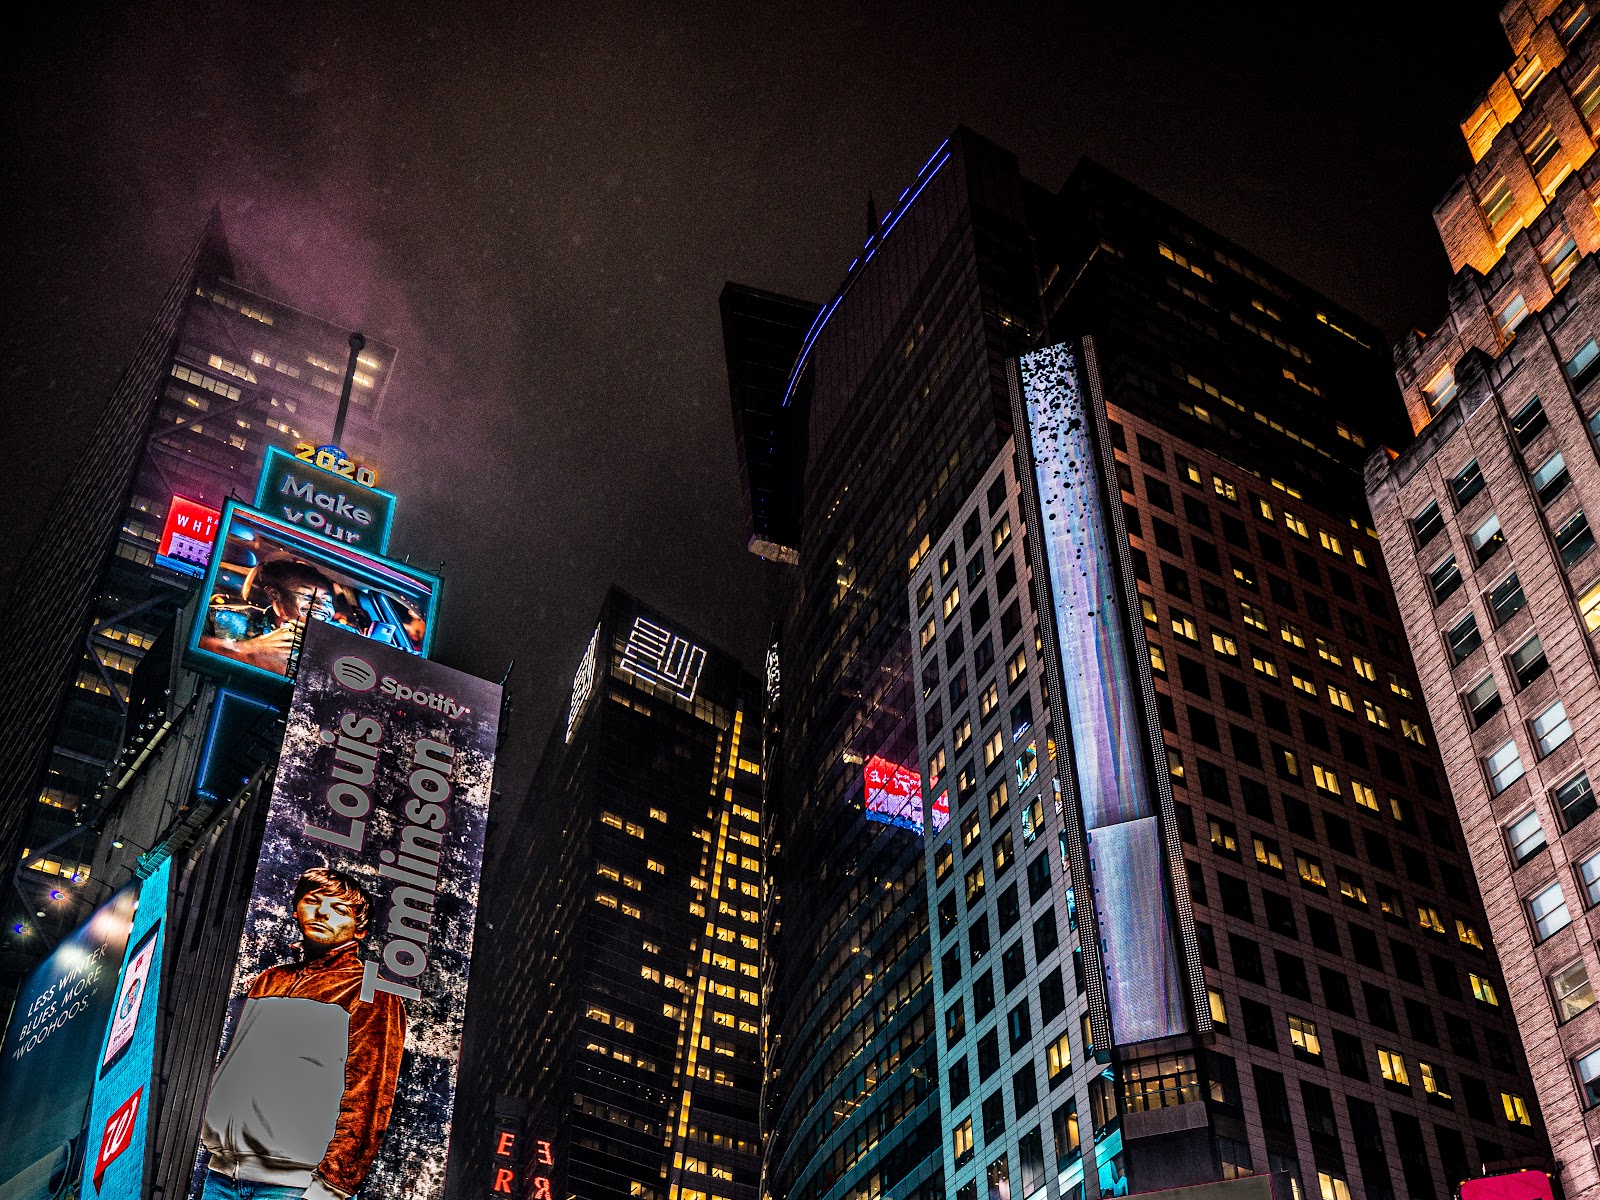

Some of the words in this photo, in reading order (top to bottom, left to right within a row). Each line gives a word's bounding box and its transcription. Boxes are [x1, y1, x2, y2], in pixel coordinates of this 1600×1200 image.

[295, 443, 377, 488] 2020
[177, 513, 212, 536] WHI
[280, 475, 373, 526] Make
[380, 677, 467, 719] Spotify
[303, 713, 383, 851] Louis
[360, 738, 455, 1002] Tomlinson
[19, 1006, 57, 1042] BLUES.
[60, 965, 103, 1008] MORE
[27, 984, 57, 1017] LESS
[58, 942, 108, 991] WINTER
